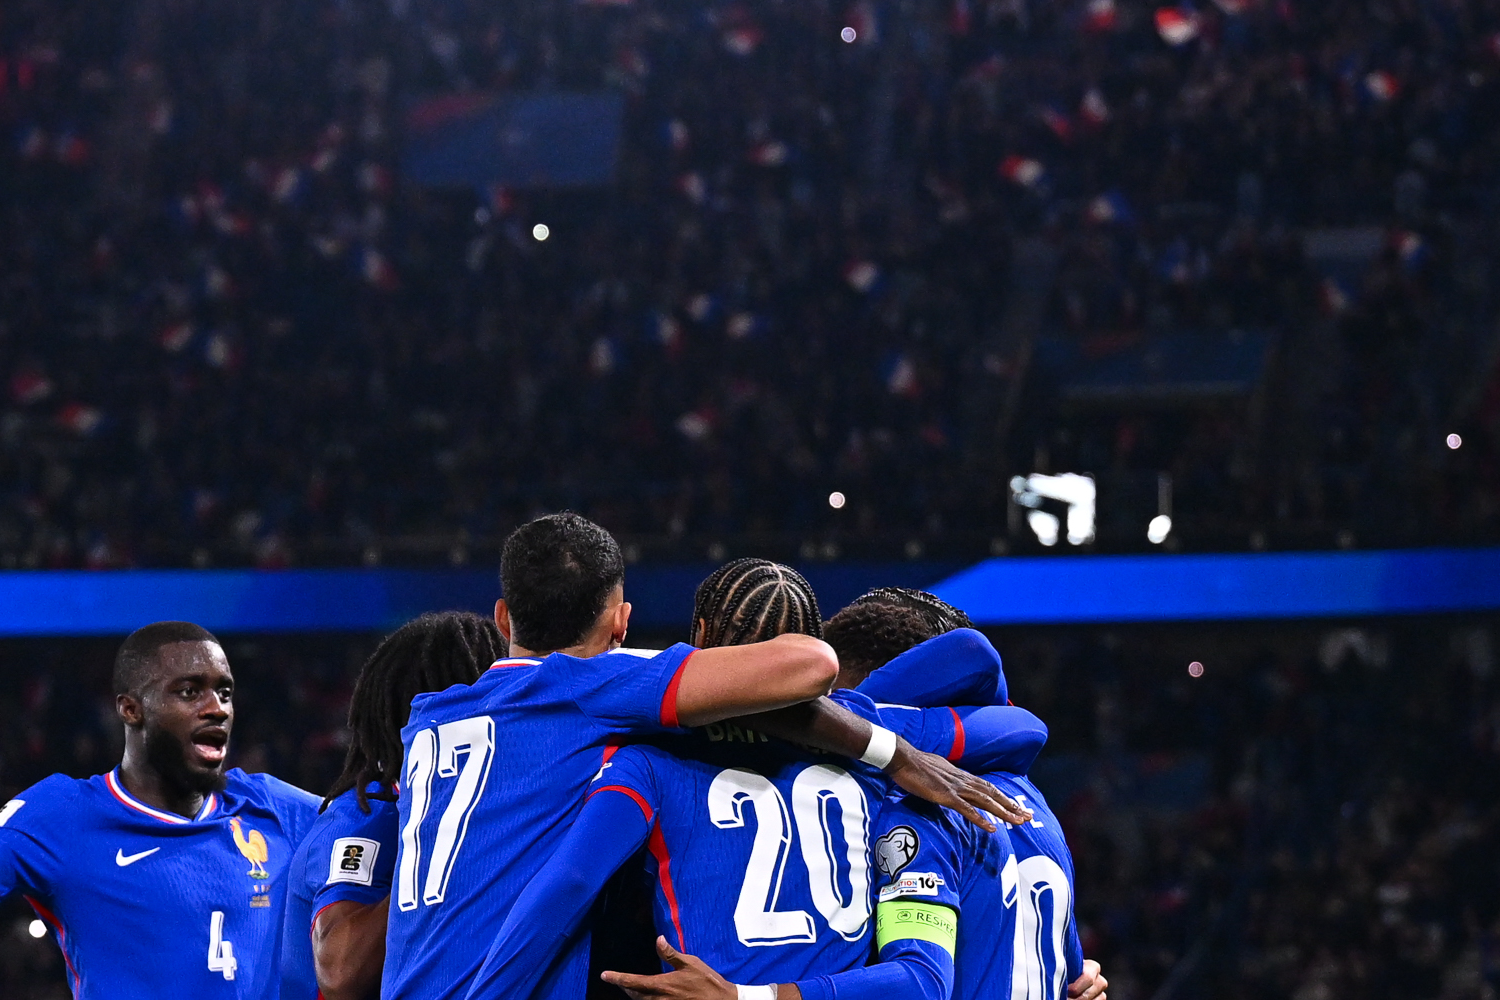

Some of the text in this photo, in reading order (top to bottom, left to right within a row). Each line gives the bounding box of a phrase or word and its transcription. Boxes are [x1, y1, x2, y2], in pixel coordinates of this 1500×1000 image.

[398, 715, 495, 912] 17
[707, 763, 872, 948] 20
[207, 910, 237, 981] 4
